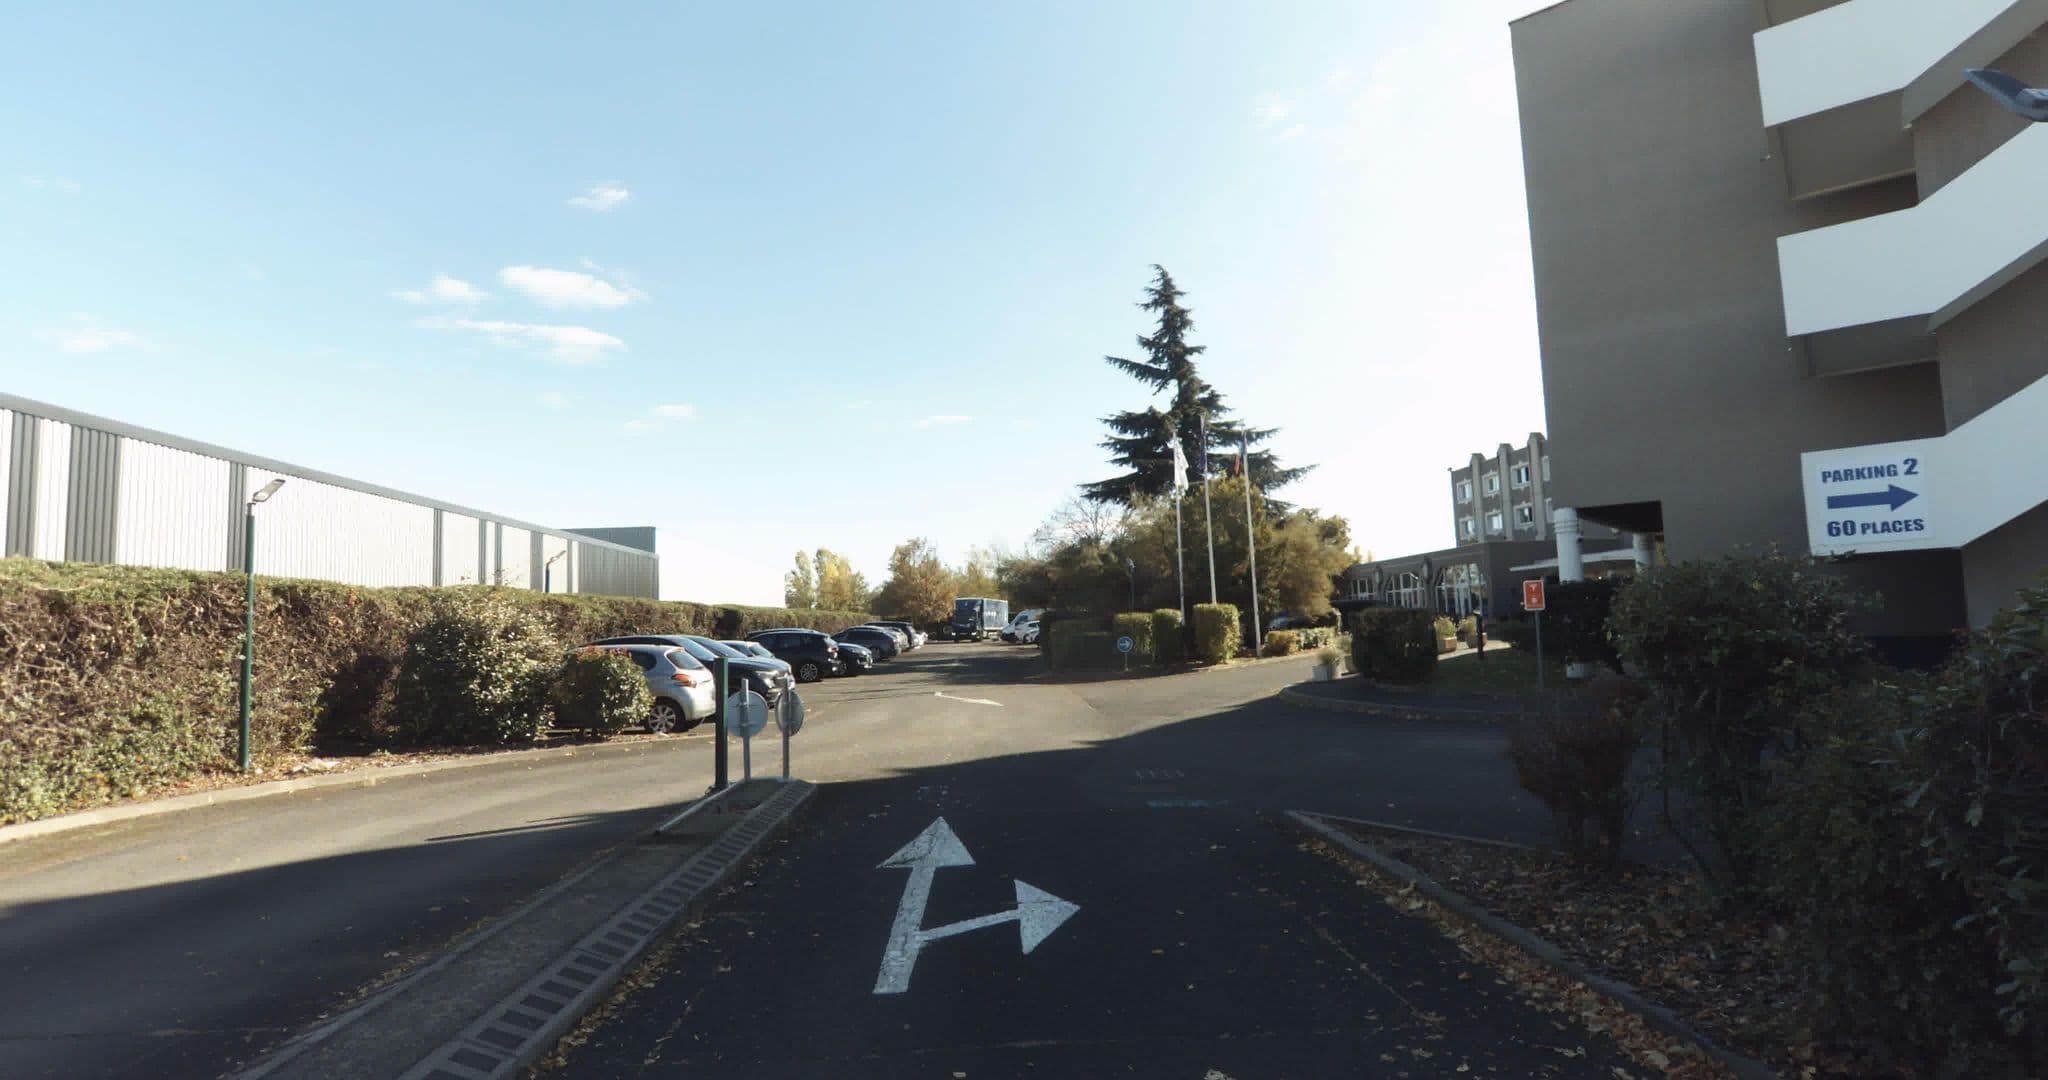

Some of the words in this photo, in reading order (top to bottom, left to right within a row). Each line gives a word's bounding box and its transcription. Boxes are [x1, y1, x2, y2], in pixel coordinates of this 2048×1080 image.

[1821, 464, 1898, 483] PARKING
[1903, 458, 1918, 475] 2
[1827, 520, 1857, 537] 60
[1861, 518, 1925, 535] PLACES
